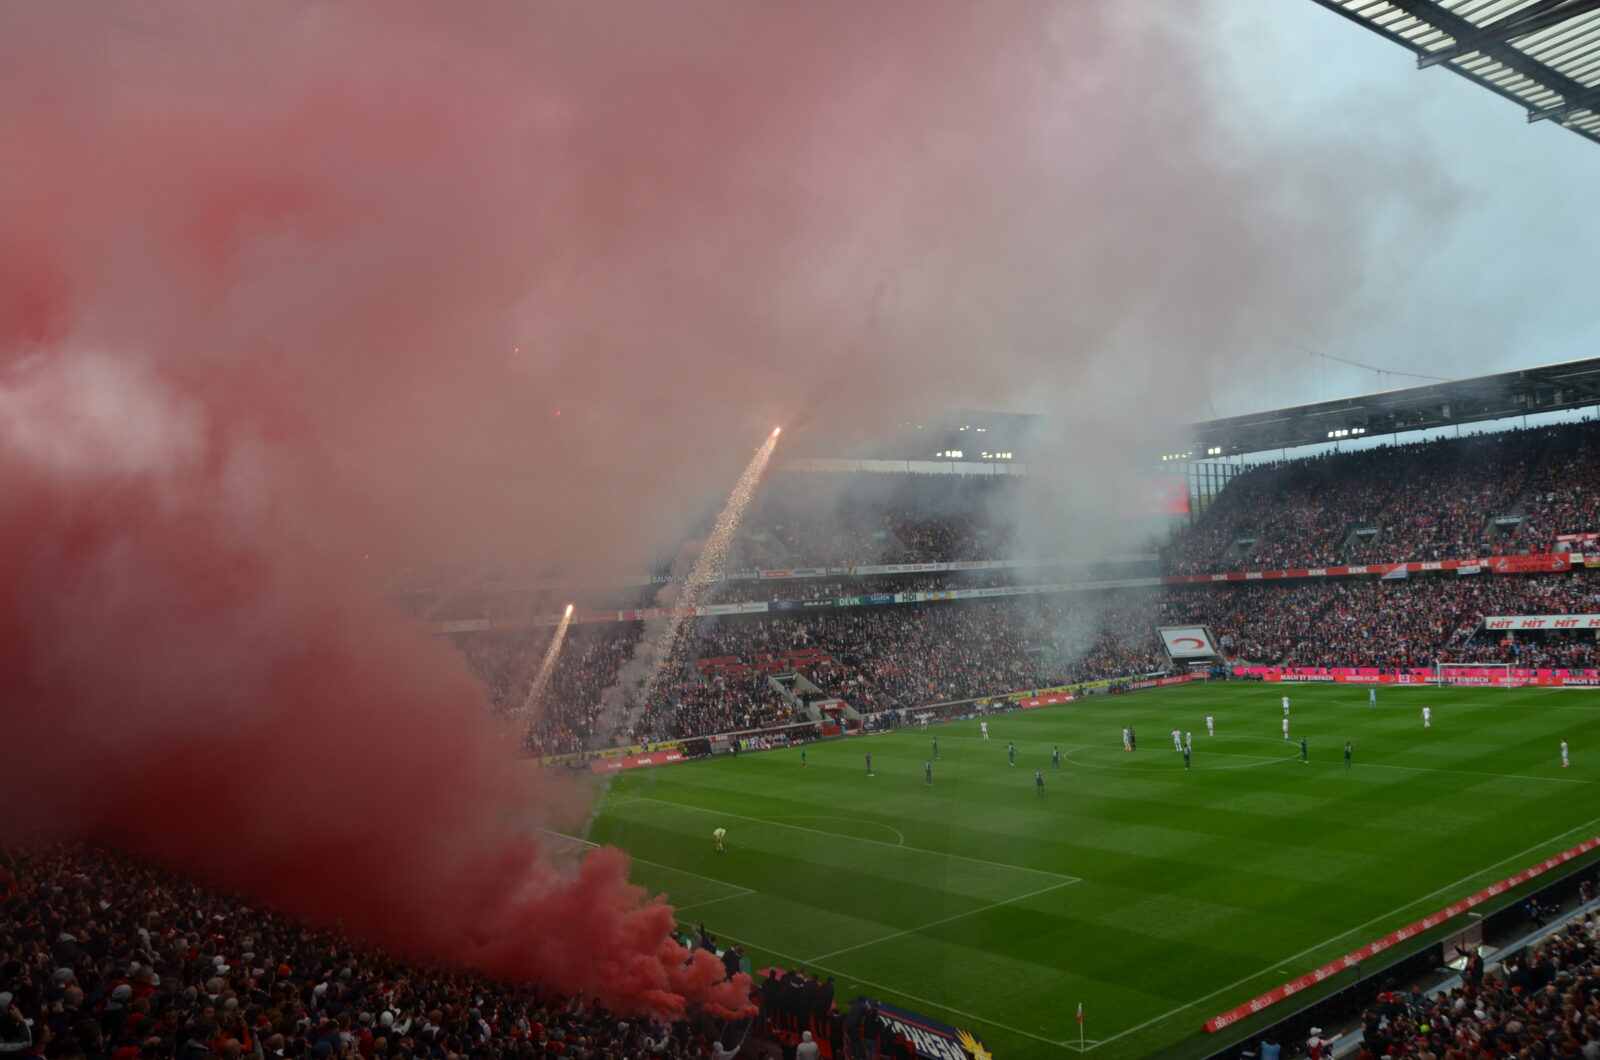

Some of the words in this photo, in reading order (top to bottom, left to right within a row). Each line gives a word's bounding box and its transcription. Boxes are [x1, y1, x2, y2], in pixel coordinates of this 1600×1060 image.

[839, 597, 860, 606] DEVK
[902, 593, 916, 602] HDI
[1554, 619, 1579, 627] HIT
[1214, 1012, 1240, 1030] DERTOUR
